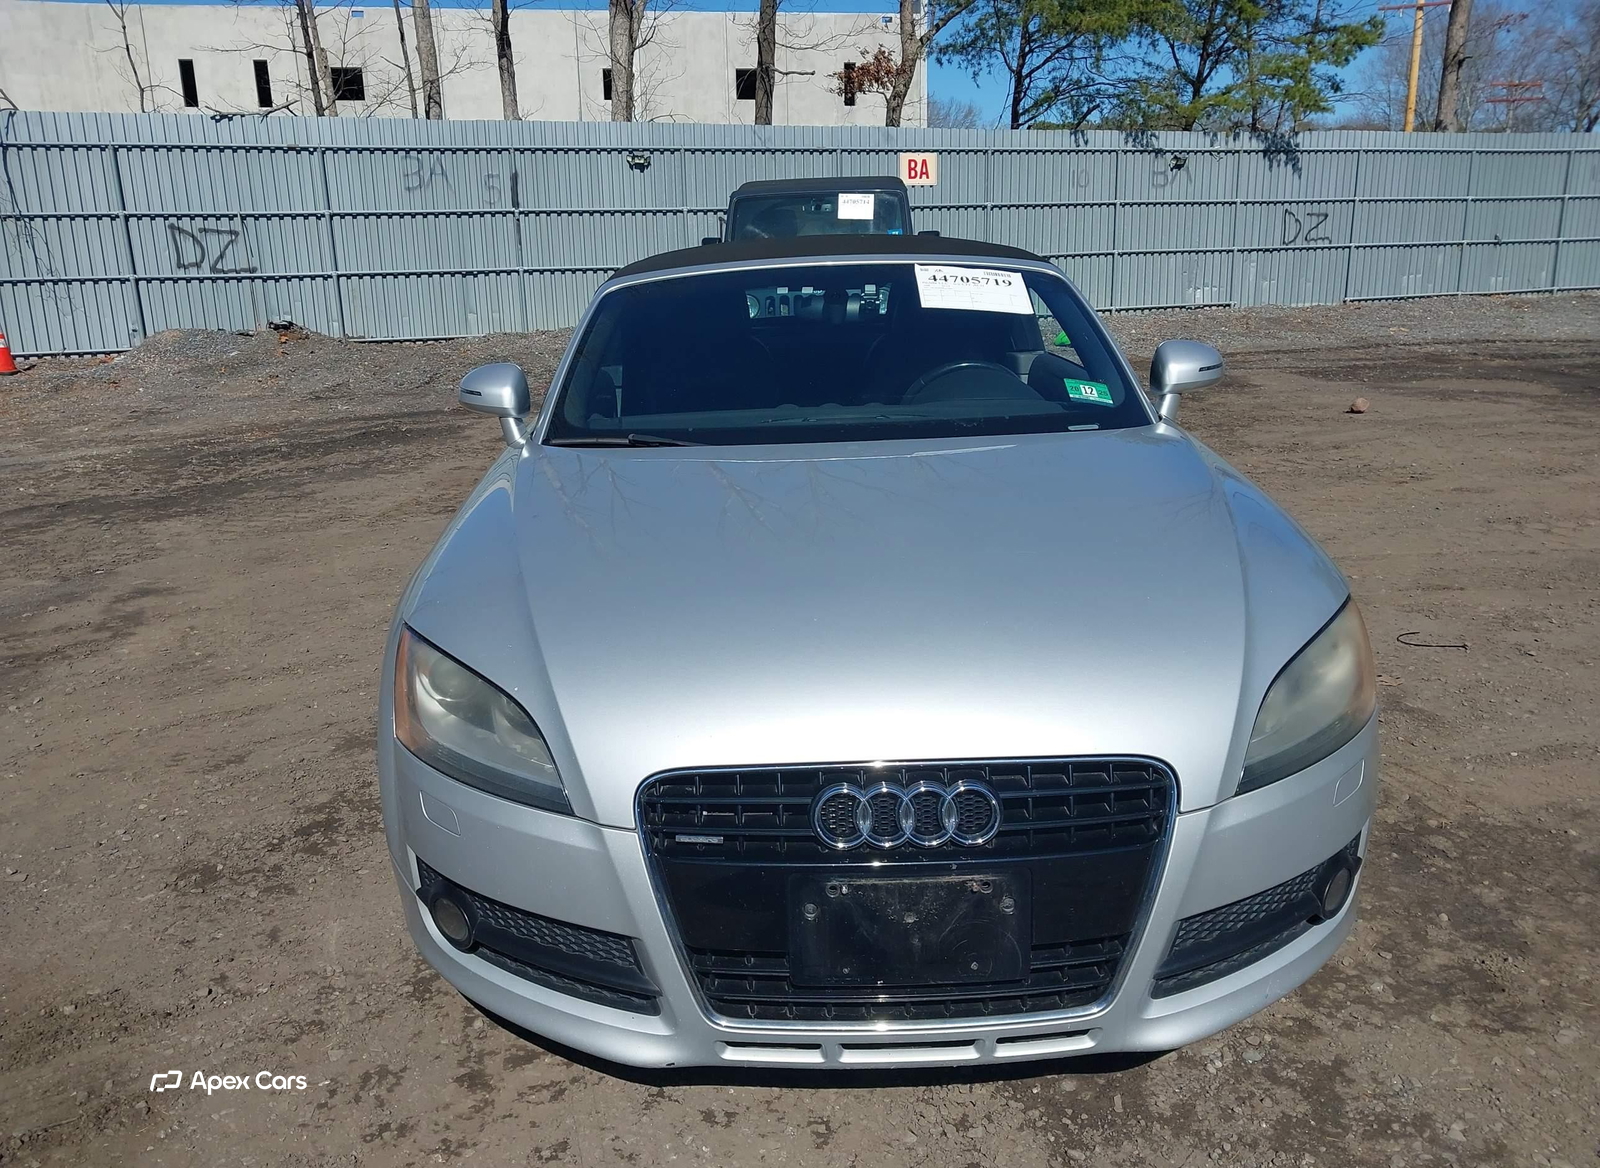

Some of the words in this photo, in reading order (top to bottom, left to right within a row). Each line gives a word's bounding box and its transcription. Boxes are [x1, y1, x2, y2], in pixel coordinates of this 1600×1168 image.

[907, 158, 930, 180] BA
[1283, 208, 1333, 246] DZ
[167, 222, 258, 275] DZ
[928, 274, 1012, 287] 44705719
[1082, 386, 1096, 396] 12
